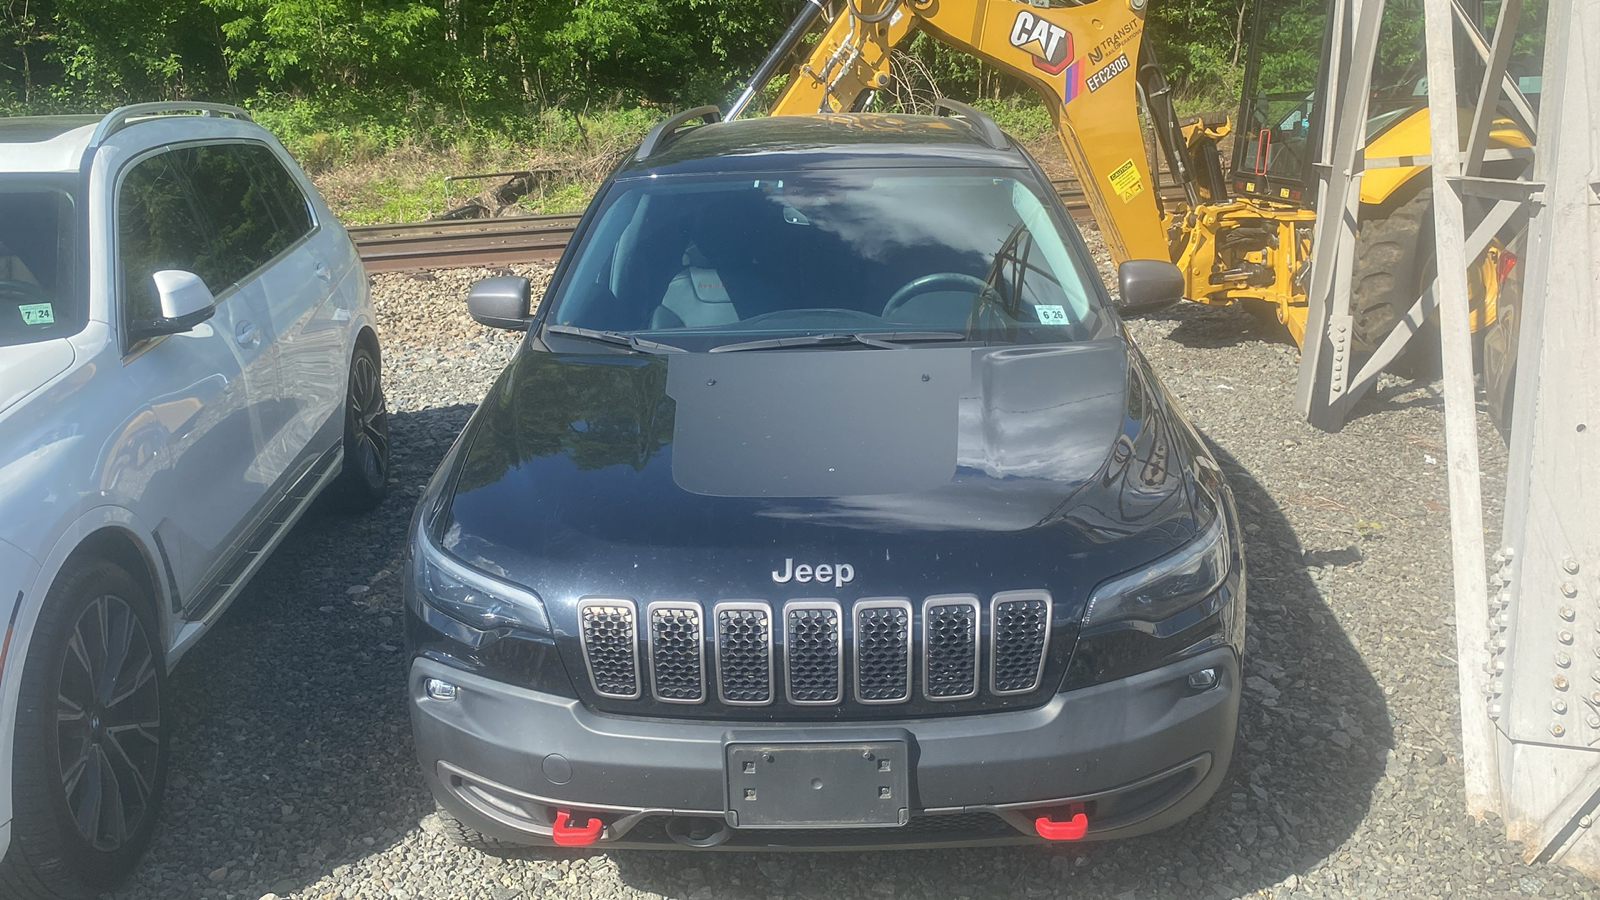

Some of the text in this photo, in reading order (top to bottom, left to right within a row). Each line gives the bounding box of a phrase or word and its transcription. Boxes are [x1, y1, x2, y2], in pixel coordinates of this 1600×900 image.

[1010, 11, 1066, 61] CAT
[1100, 18, 1138, 50] TRANSIT
[1086, 55, 1129, 92] EFC2306
[25, 309, 50, 320] 7 24
[1043, 310, 1064, 320] 6 26
[772, 558, 855, 588] Jeep
